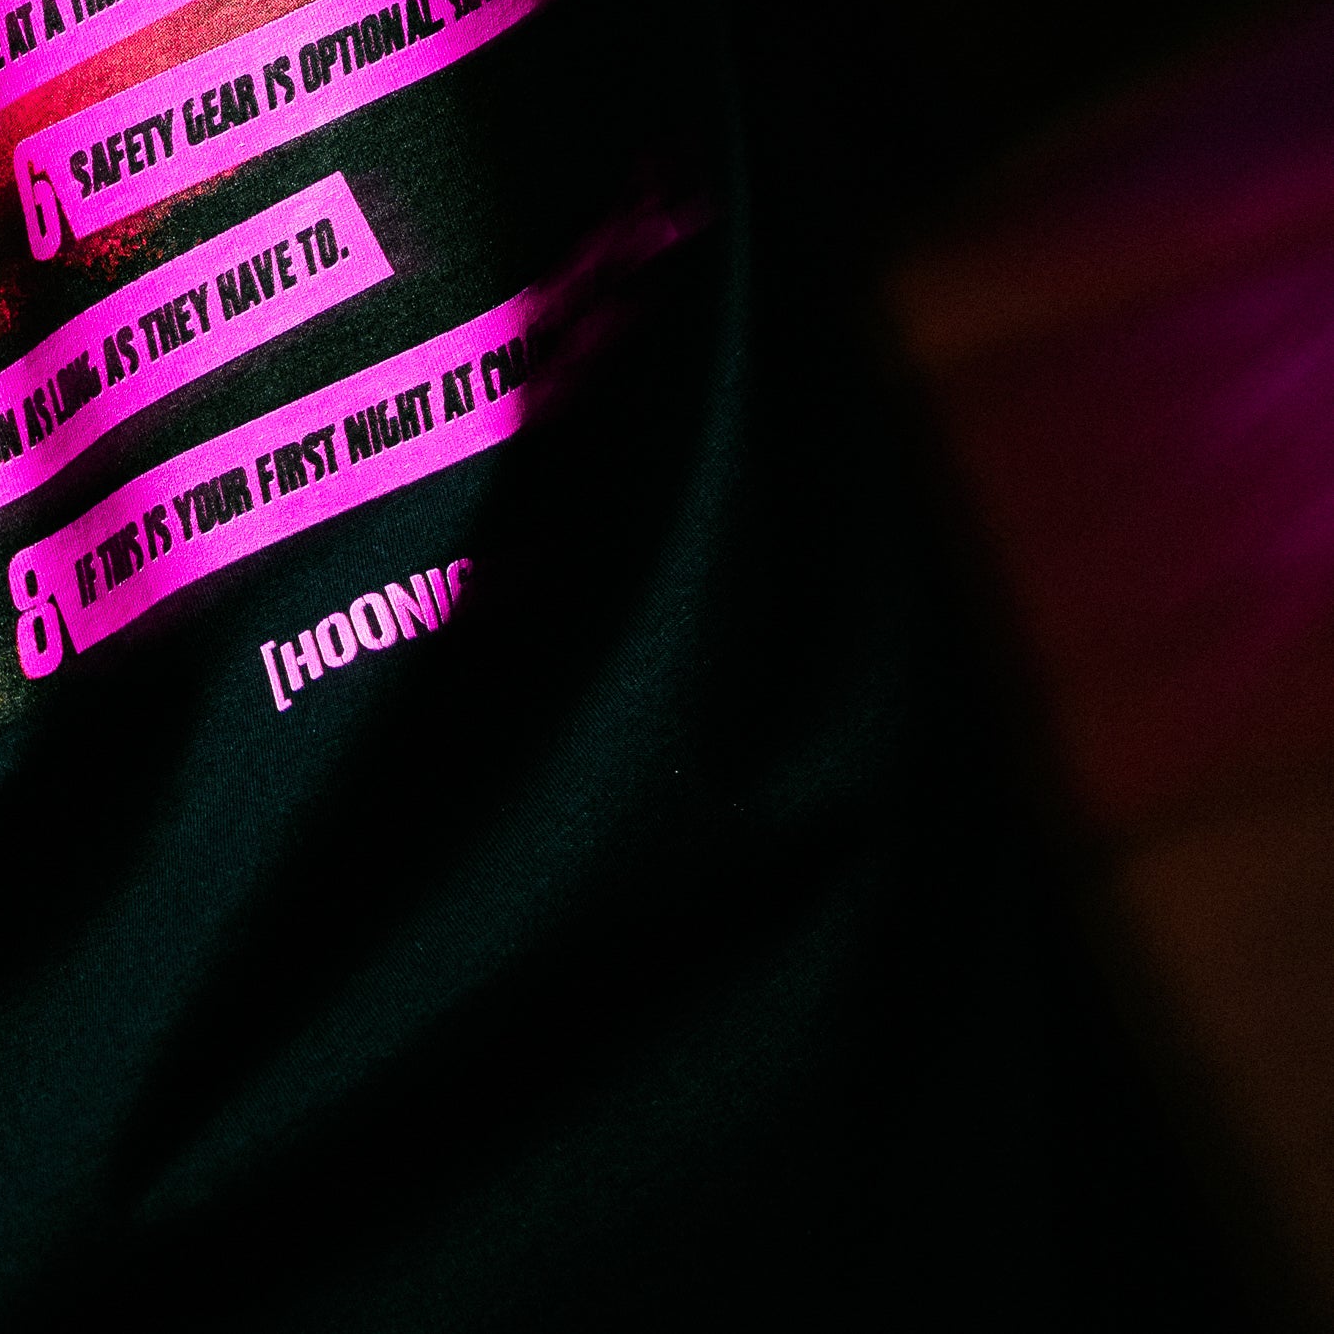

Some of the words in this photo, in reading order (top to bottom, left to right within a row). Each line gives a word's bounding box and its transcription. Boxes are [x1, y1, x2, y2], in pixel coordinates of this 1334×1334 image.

[5, 2, 37, 63] AT
[69, 108, 175, 200] SAFETY
[183, 76, 258, 147] GEAR
[262, 54, 295, 112] IS
[23, 392, 51, 449] AS
[49, 352, 102, 425] LONG
[104, 326, 140, 387] AS
[139, 283, 211, 361] THEY
[214, 240, 298, 321] HAVE
[298, 217, 350, 277] TO.
[74, 557, 101, 610] IF
[99, 521, 144, 593] THIS
[144, 504, 173, 562] IS
[173, 466, 255, 542] YOUR
[257, 423, 339, 505] FIRST
[344, 382, 437, 465] NIGHT
[441, 363, 475, 424] AT
